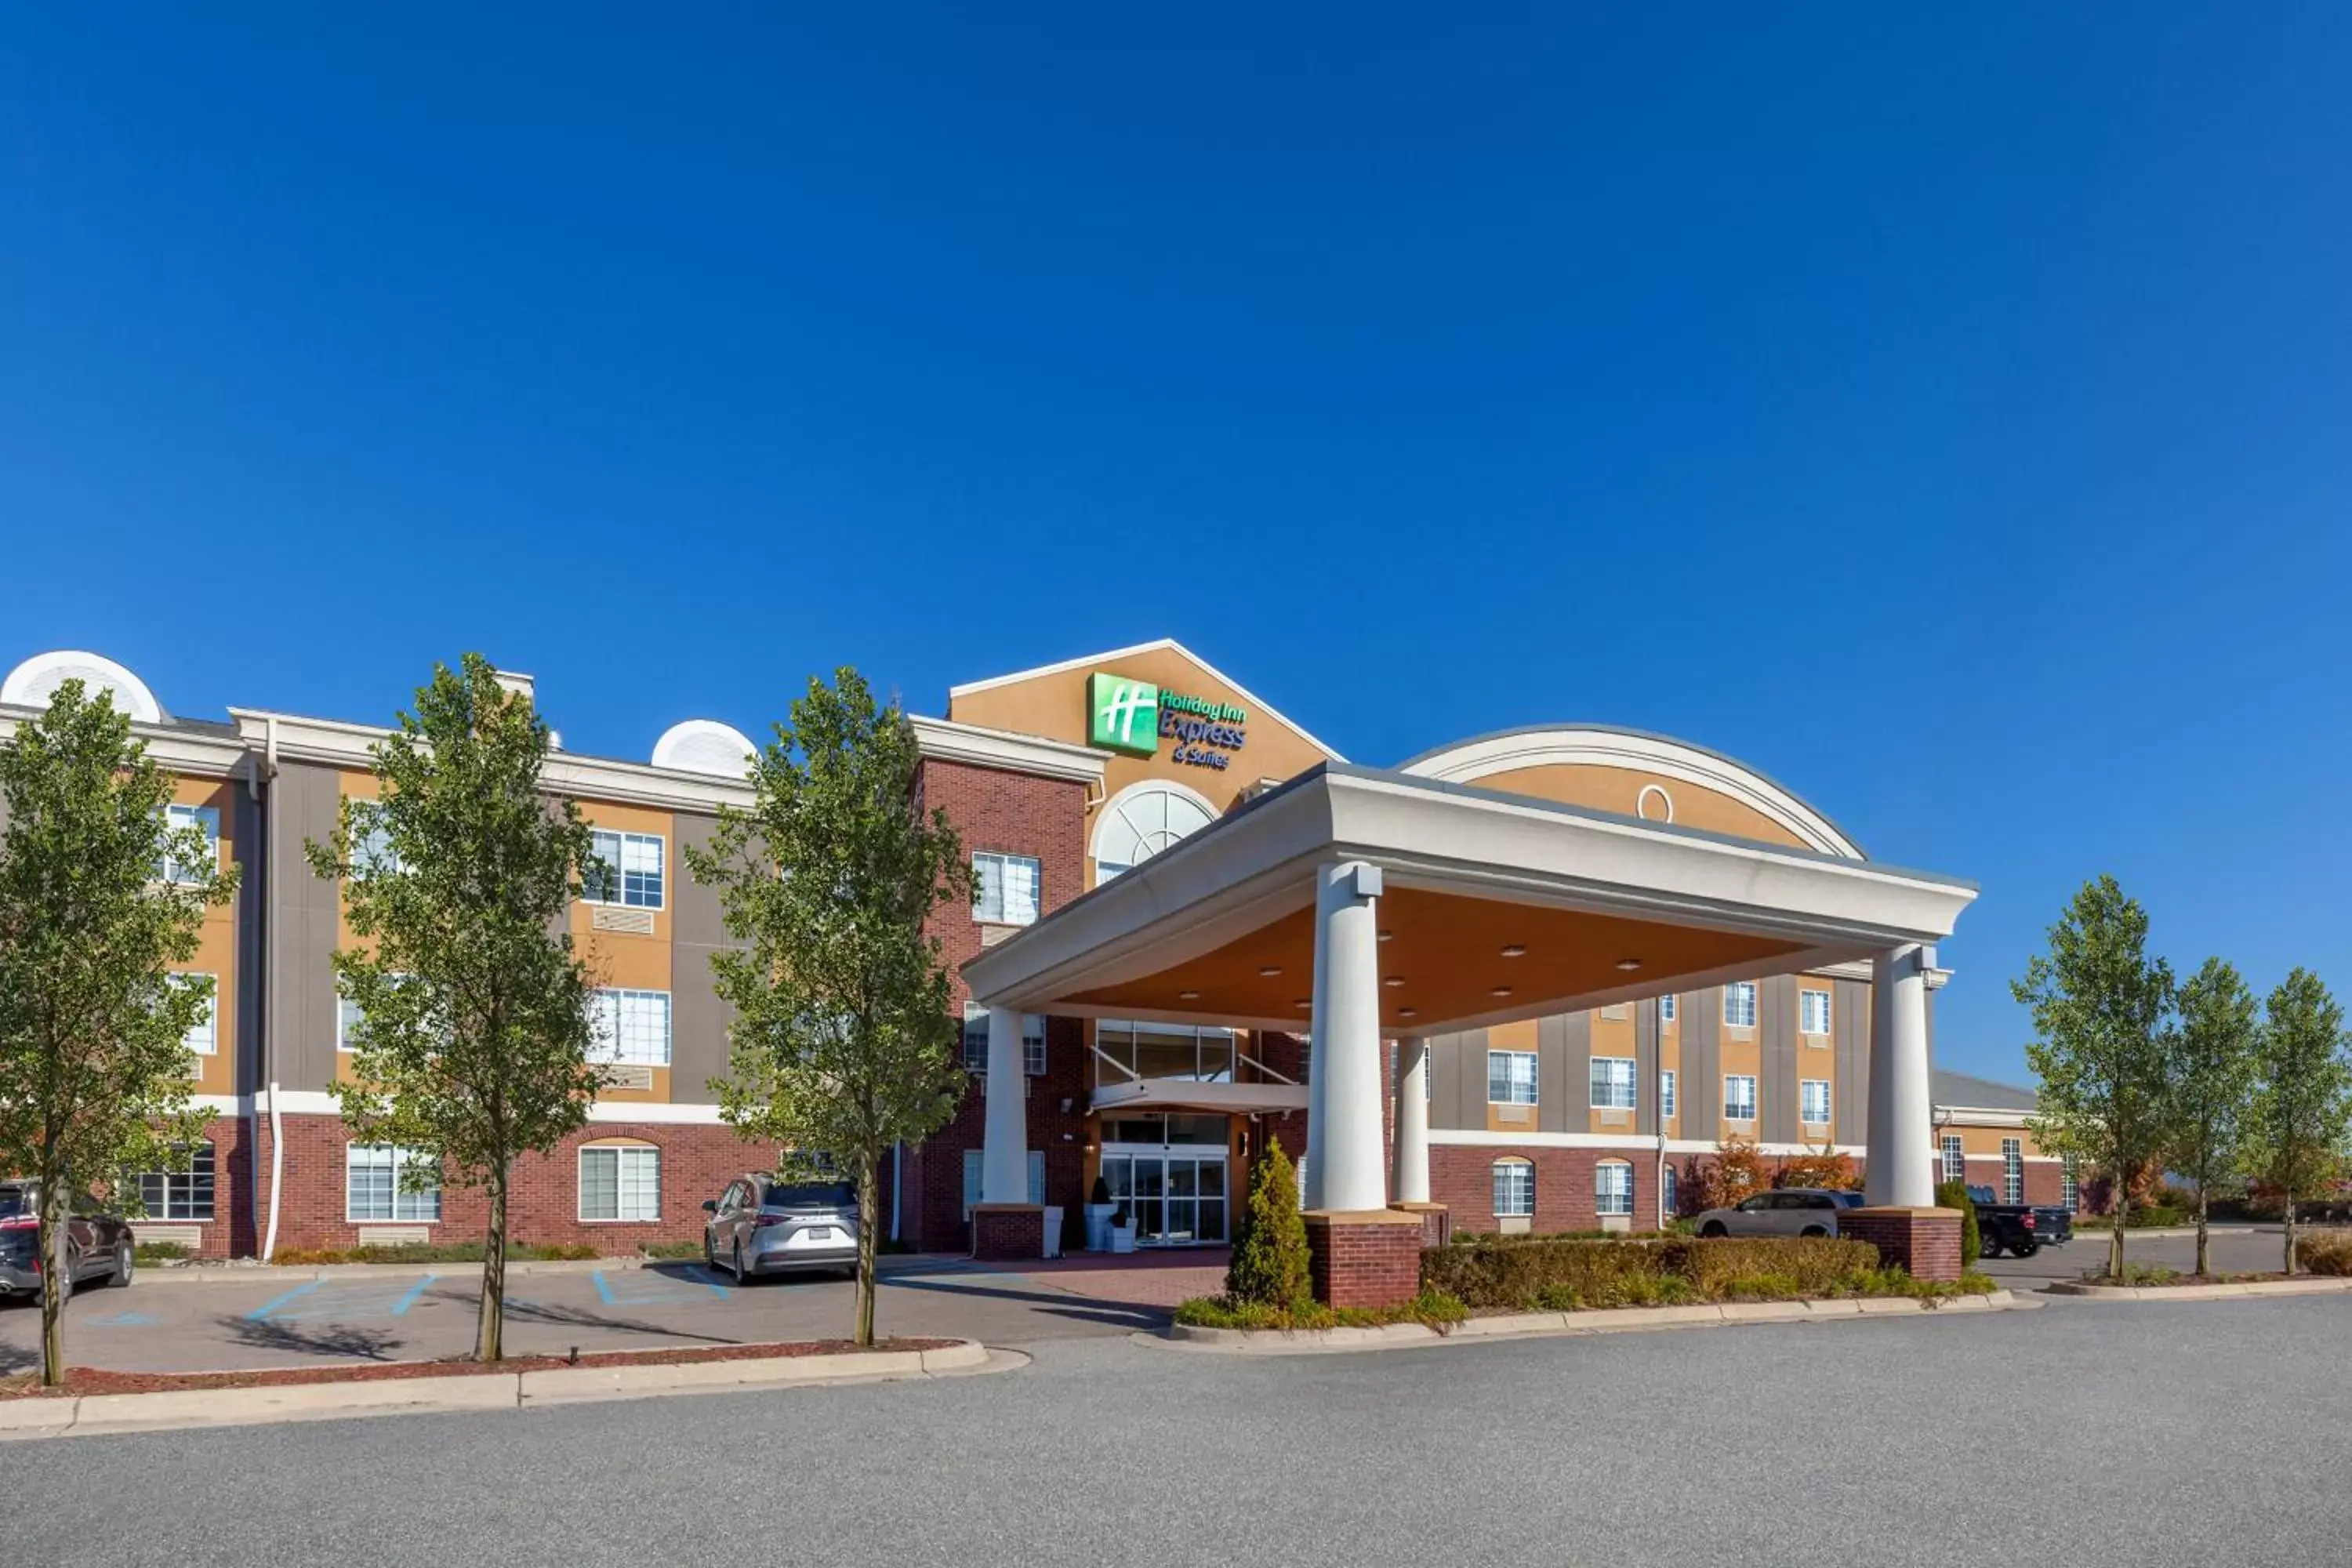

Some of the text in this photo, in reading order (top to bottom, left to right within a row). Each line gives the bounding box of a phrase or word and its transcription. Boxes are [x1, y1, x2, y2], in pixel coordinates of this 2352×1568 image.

[1159, 689, 1247, 721] Holiday Inn
[1160, 709, 1247, 746] Express
[1174, 746, 1229, 768] & Suites
